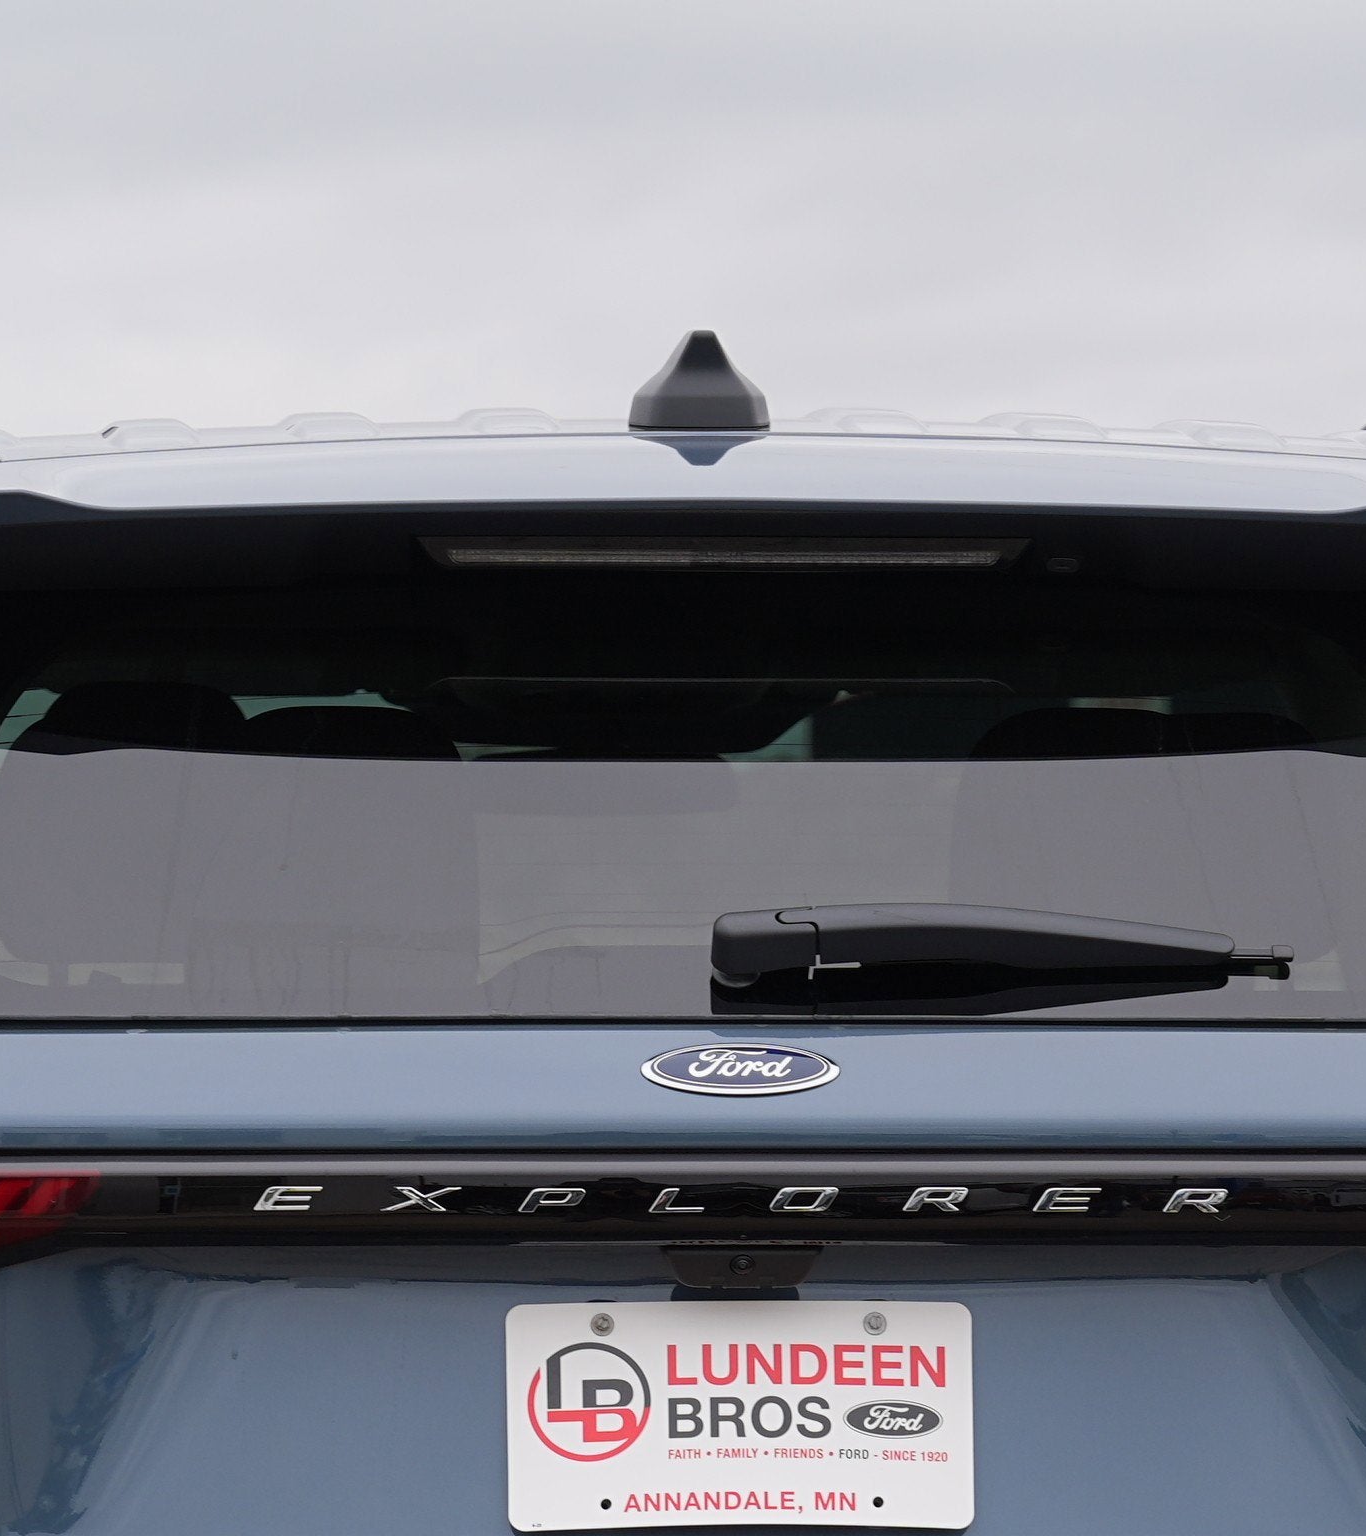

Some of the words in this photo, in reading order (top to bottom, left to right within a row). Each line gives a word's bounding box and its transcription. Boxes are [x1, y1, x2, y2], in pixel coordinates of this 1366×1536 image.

[688, 1049, 793, 1078] Ford
[253, 1185, 1229, 1214] EXPLORER
[667, 1343, 946, 1388] LUNDEEN
[668, 1395, 832, 1439] BROS
[863, 1404, 924, 1433] Ford
[668, 1448, 702, 1460] FAITH
[716, 1448, 758, 1460] FAMILY
[773, 1448, 824, 1460] FRIENDS
[838, 1448, 869, 1460] FORD
[882, 1450, 917, 1461] SINCE
[921, 1450, 948, 1462] 1920
[623, 1491, 804, 1514] ANNANDALE,
[815, 1491, 857, 1512] MN
